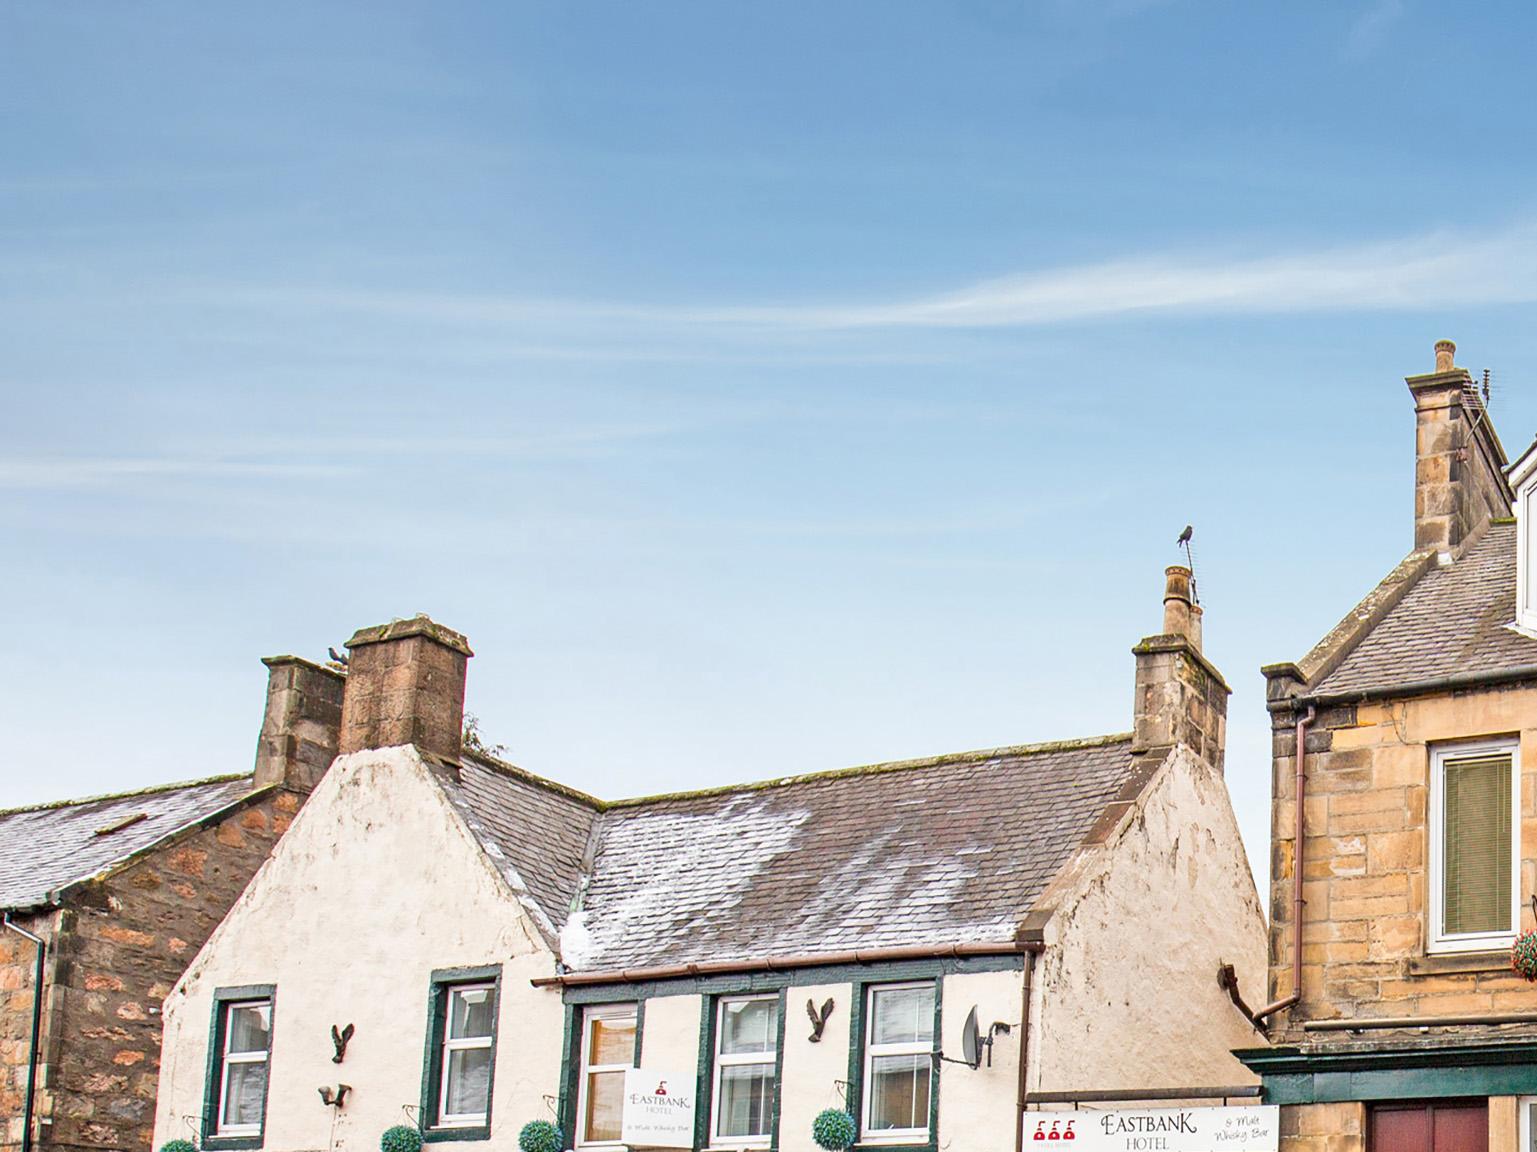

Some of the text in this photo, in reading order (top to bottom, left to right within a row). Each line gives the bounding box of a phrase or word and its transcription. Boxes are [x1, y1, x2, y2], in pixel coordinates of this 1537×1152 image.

[630, 1093, 691, 1109] EASTBANK
[646, 1105, 673, 1115] HOTEL
[1100, 1112, 1198, 1136] EASTBANK
[1236, 1116, 1261, 1127] Malt
[1215, 1127, 1270, 1143] Whisky Bar
[1126, 1137, 1170, 1151] HOTEL
